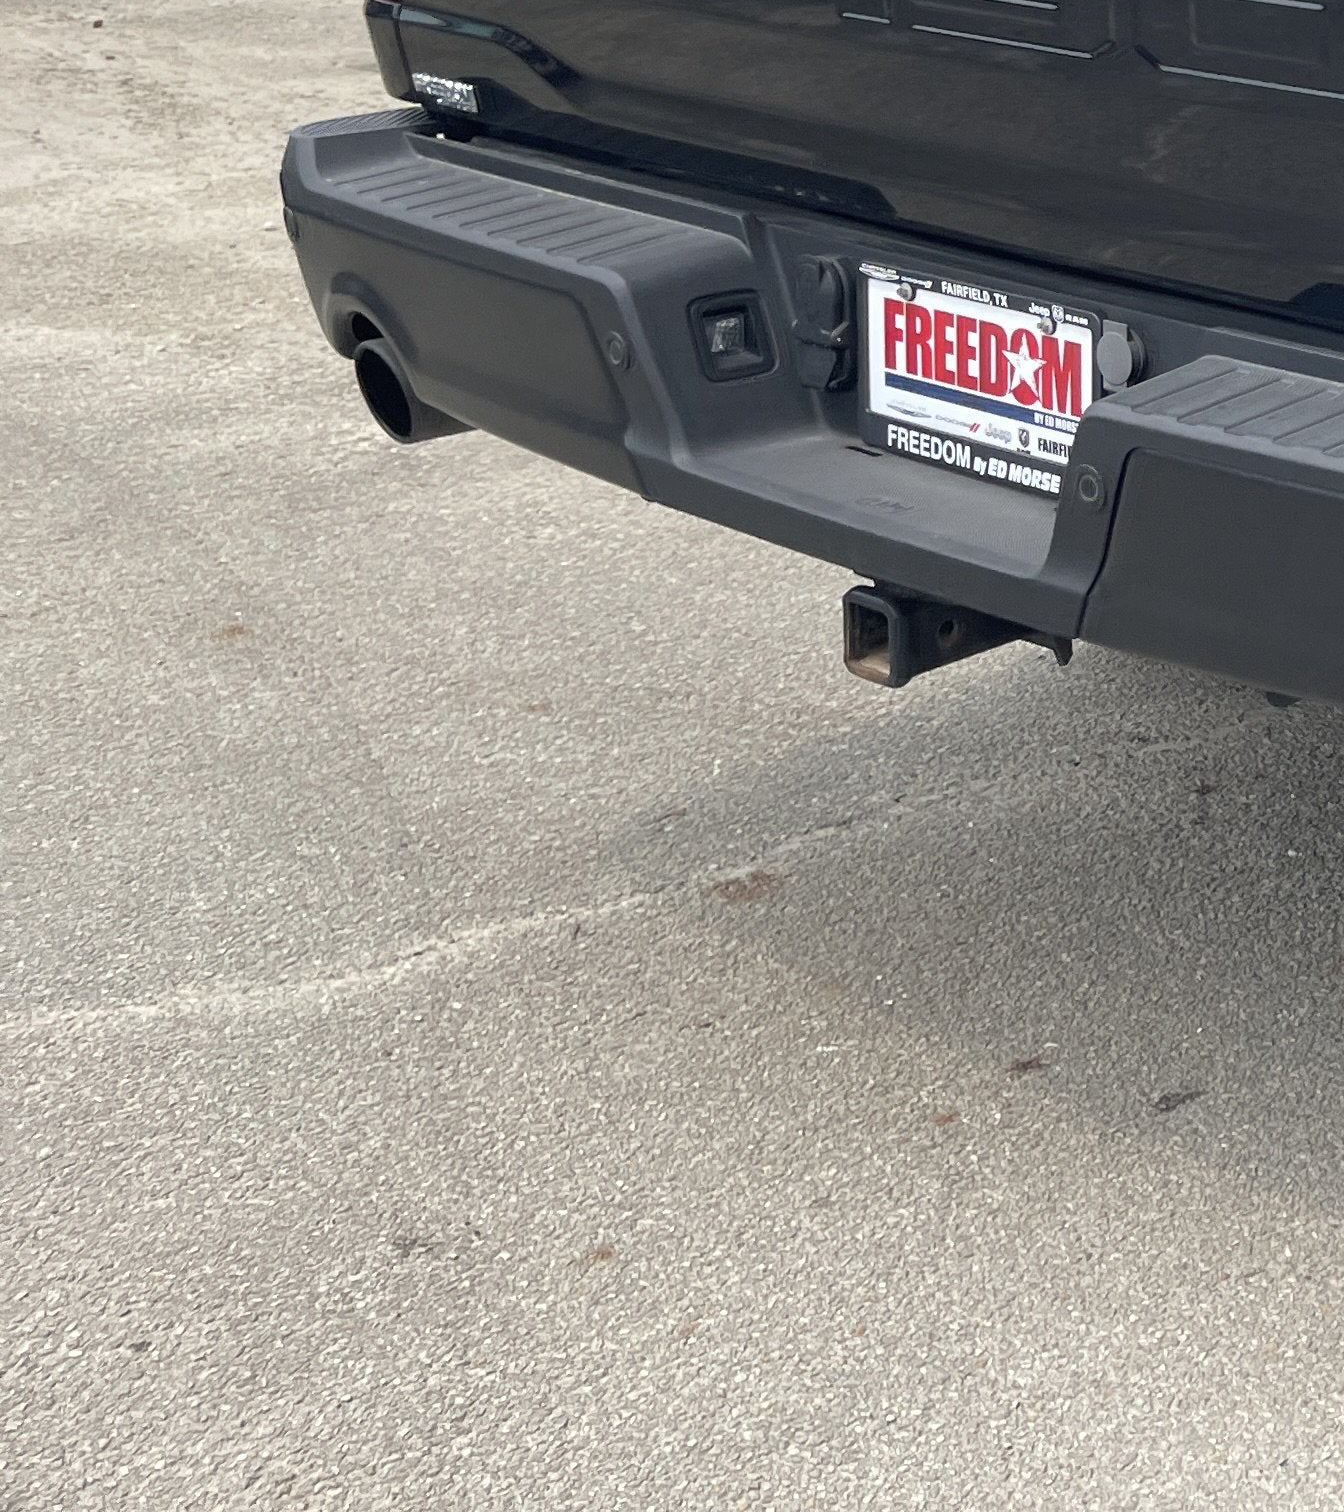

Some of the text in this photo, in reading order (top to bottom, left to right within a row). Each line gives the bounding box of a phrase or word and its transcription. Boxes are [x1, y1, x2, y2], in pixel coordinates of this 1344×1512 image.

[941, 280, 1008, 308] FAIRFIELD, TX
[884, 297, 1083, 418] FREEDOM
[984, 422, 1014, 445] Jeep
[1033, 411, 1079, 434] BY ED MORS
[886, 423, 972, 470] FREEDOM
[987, 457, 1009, 480] ED
[1008, 462, 1062, 495] MORSE
[1037, 437, 1071, 459] FAIRFI
